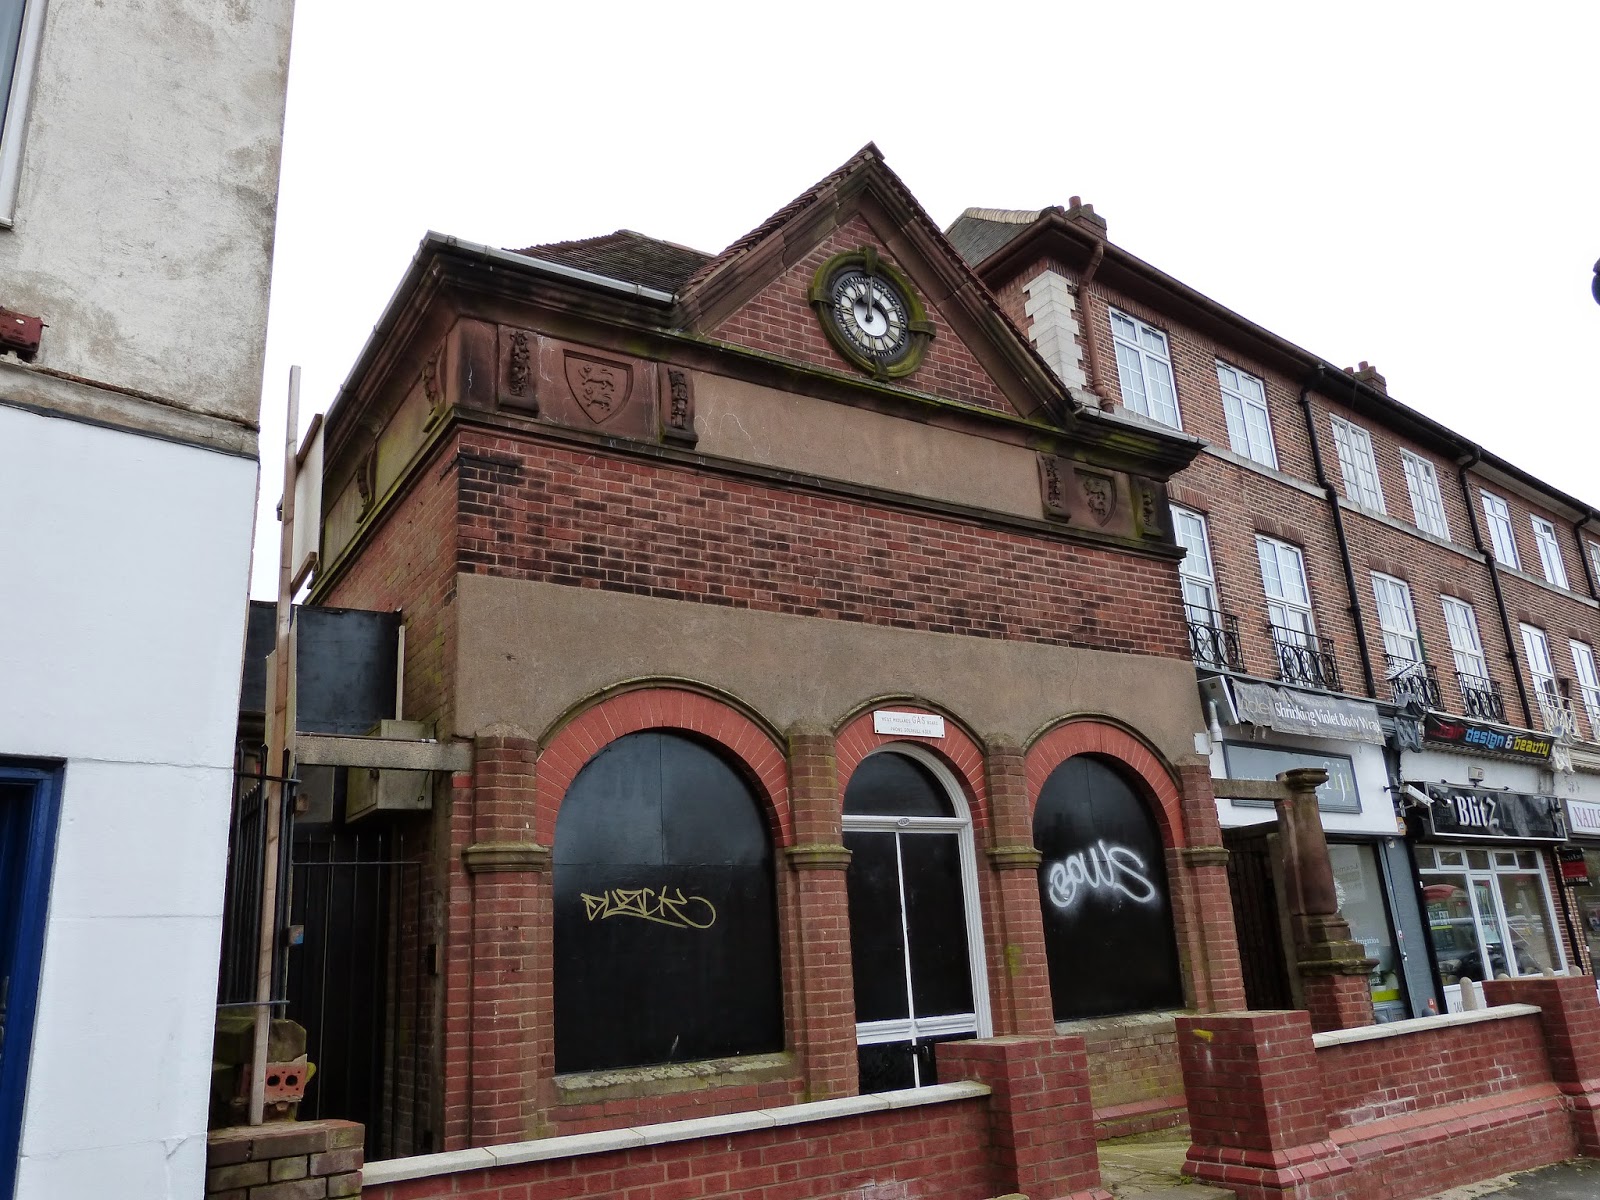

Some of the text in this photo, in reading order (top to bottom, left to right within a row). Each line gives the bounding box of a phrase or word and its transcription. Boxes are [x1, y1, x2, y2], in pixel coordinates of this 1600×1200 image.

[911, 715, 926, 725] GAS
[1274, 702, 1317, 727] Shrinking
[1314, 709, 1341, 726] Violet
[1339, 713, 1360, 732] Body
[1465, 727, 1505, 749] design
[1504, 735, 1513, 749] &
[1513, 736, 1550, 757] beauty
